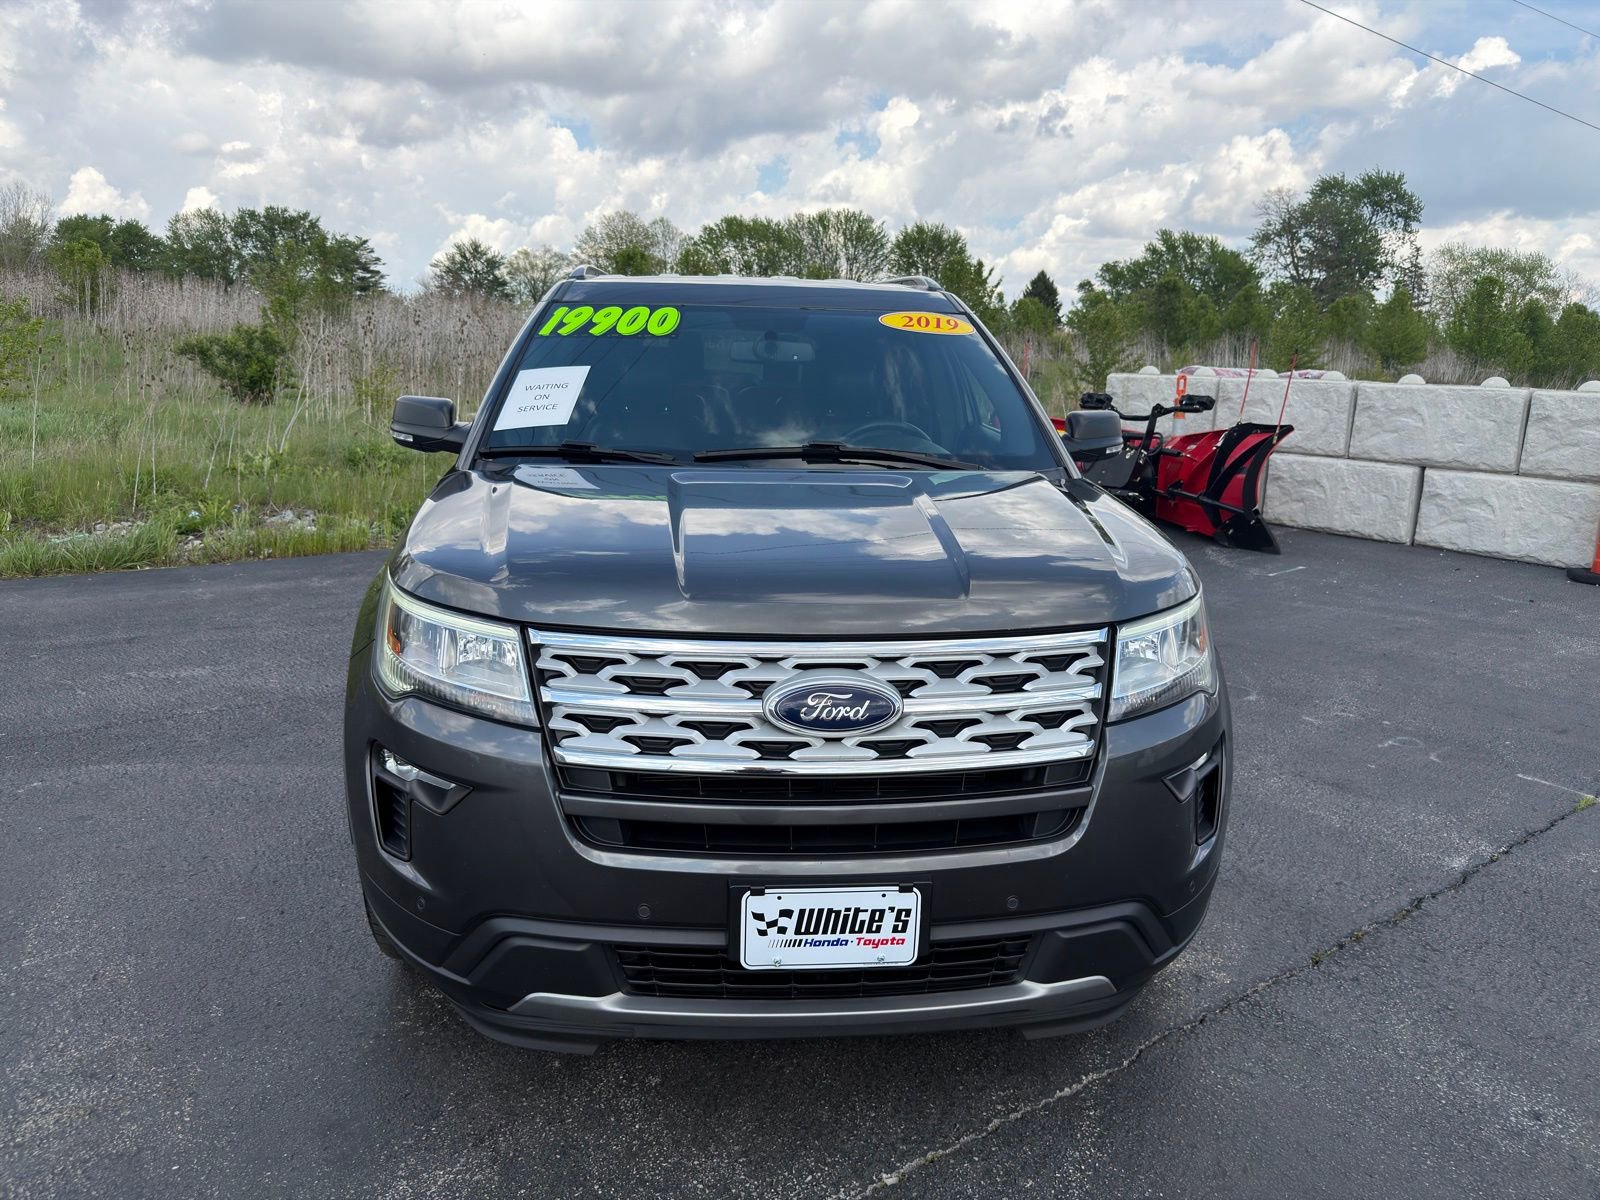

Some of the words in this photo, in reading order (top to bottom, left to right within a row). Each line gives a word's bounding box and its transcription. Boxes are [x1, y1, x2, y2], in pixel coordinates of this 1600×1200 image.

[538, 306, 681, 336] 19900
[901, 315, 959, 330] 2019
[524, 382, 569, 392] WAITING
[517, 403, 559, 413] SERVICE
[800, 692, 871, 721] Ford
[794, 906, 912, 936] White's
